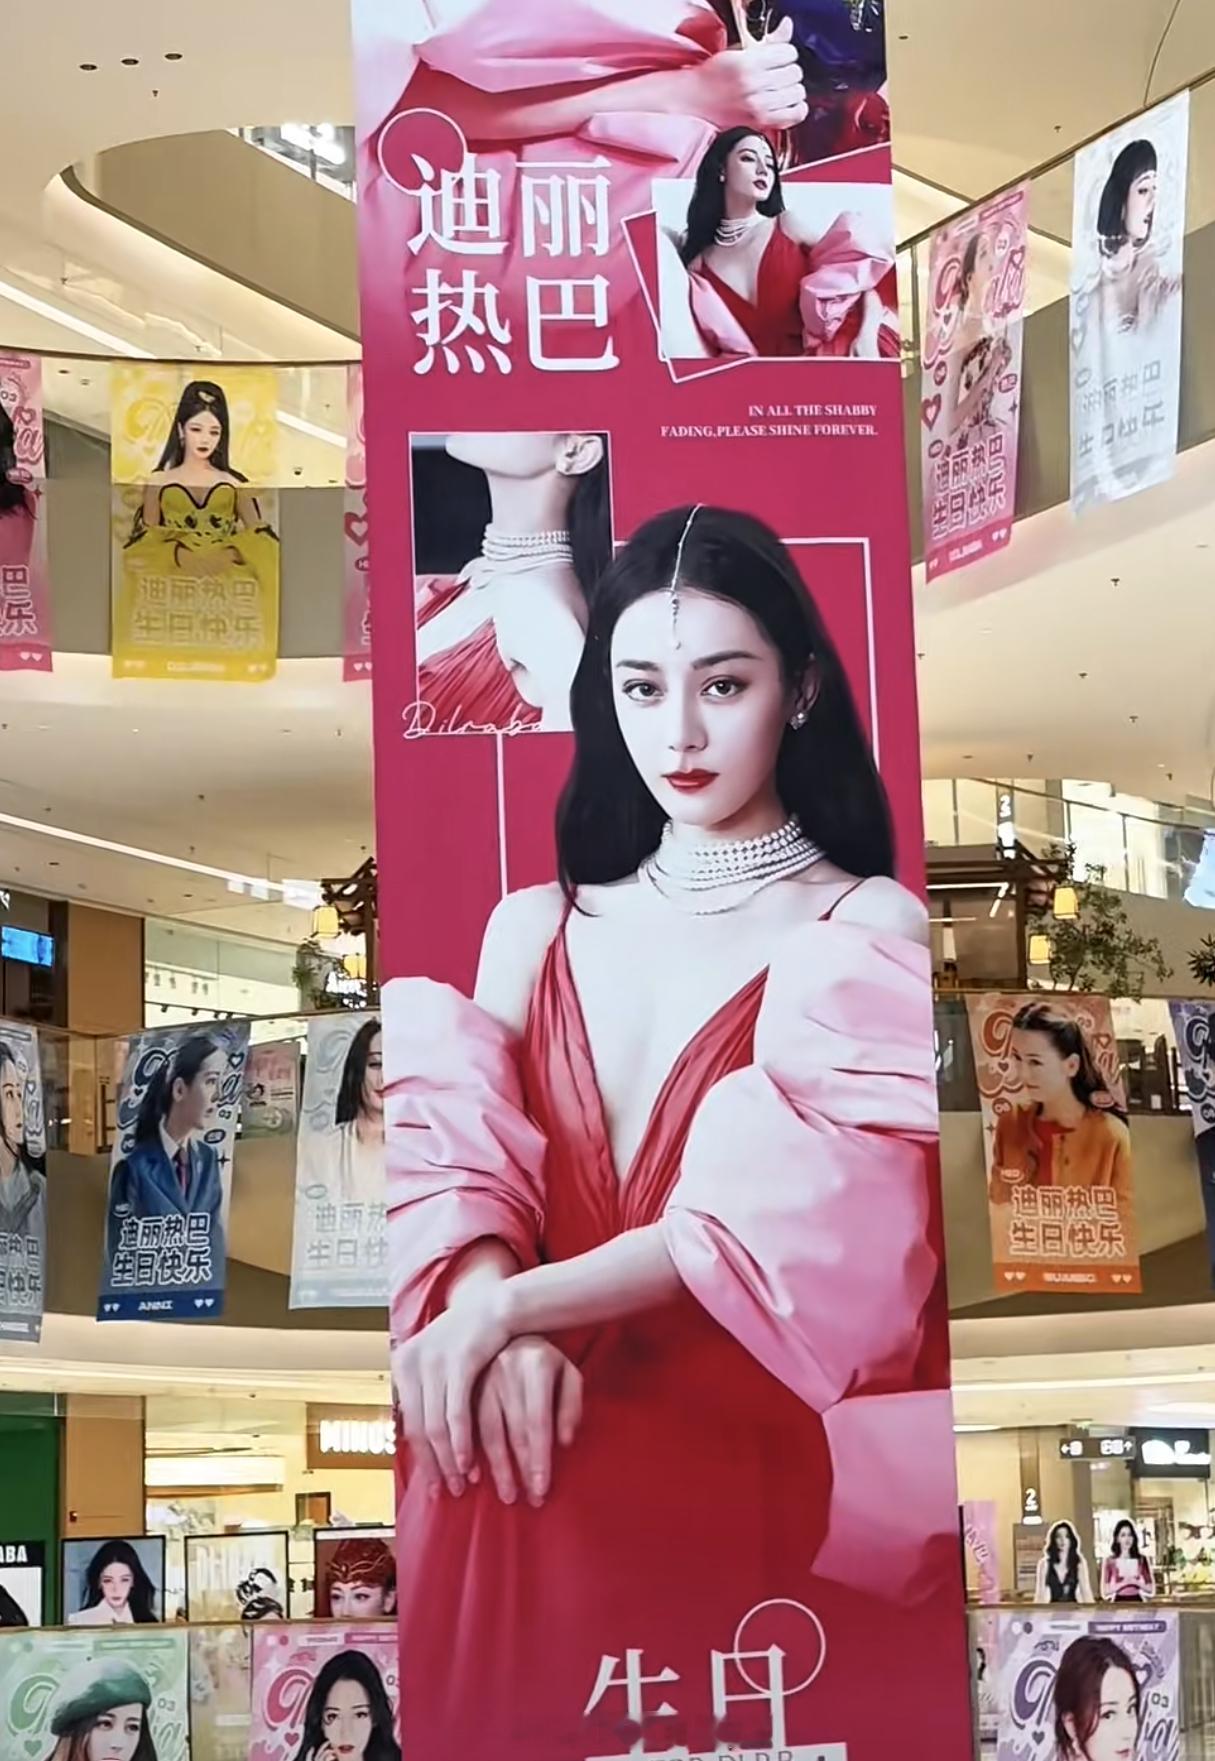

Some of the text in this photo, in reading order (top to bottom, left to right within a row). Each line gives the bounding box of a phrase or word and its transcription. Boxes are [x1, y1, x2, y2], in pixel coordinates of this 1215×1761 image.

[407, 154, 613, 258] 迪丽
[411, 269, 620, 376] 热巴
[748, 404, 878, 416] IN ALL THE SHABBY
[769, 424, 810, 436] SHINE
[814, 424, 878, 436] FOREVER.
[1011, 1185, 1118, 1220] 迪丽热巴
[118, 1212, 210, 1251] 迪丽热巴
[1009, 1219, 1127, 1258] 生日快乐
[110, 1247, 213, 1288] 生日快乐
